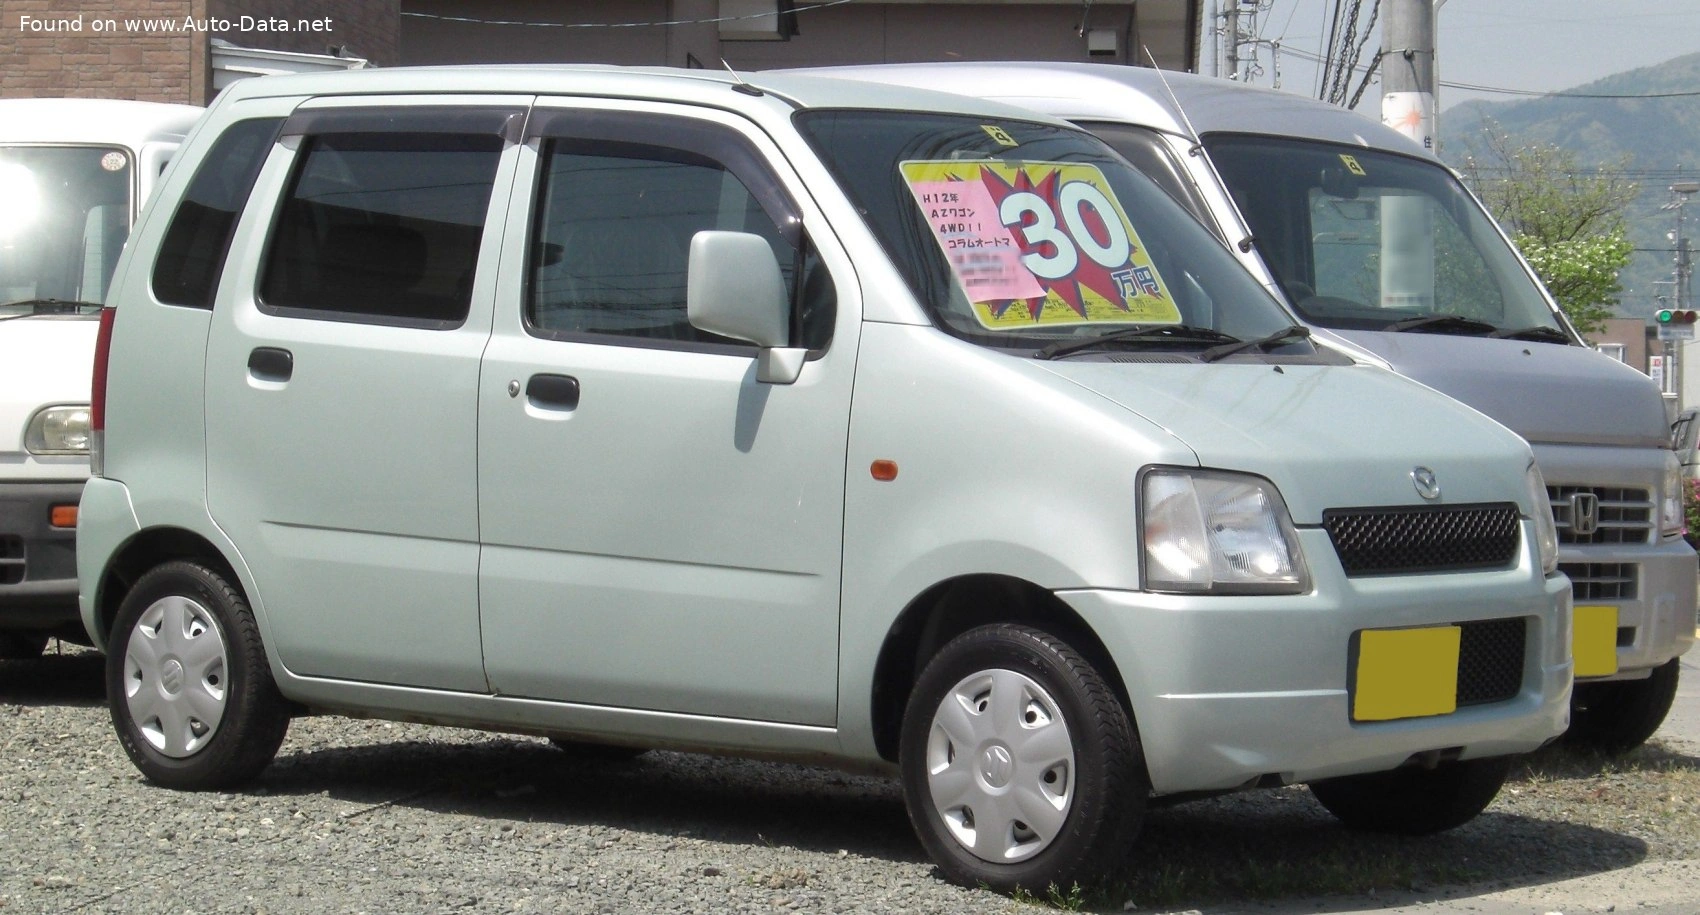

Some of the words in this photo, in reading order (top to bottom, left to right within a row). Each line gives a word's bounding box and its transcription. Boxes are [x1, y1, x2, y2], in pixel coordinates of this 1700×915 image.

[923, 193, 959, 204] H12年
[931, 208, 975, 218] AZワゴン
[948, 237, 1011, 249] コラムオートマ
[999, 180, 1130, 278] 30
[1110, 266, 1160, 299] 万円
